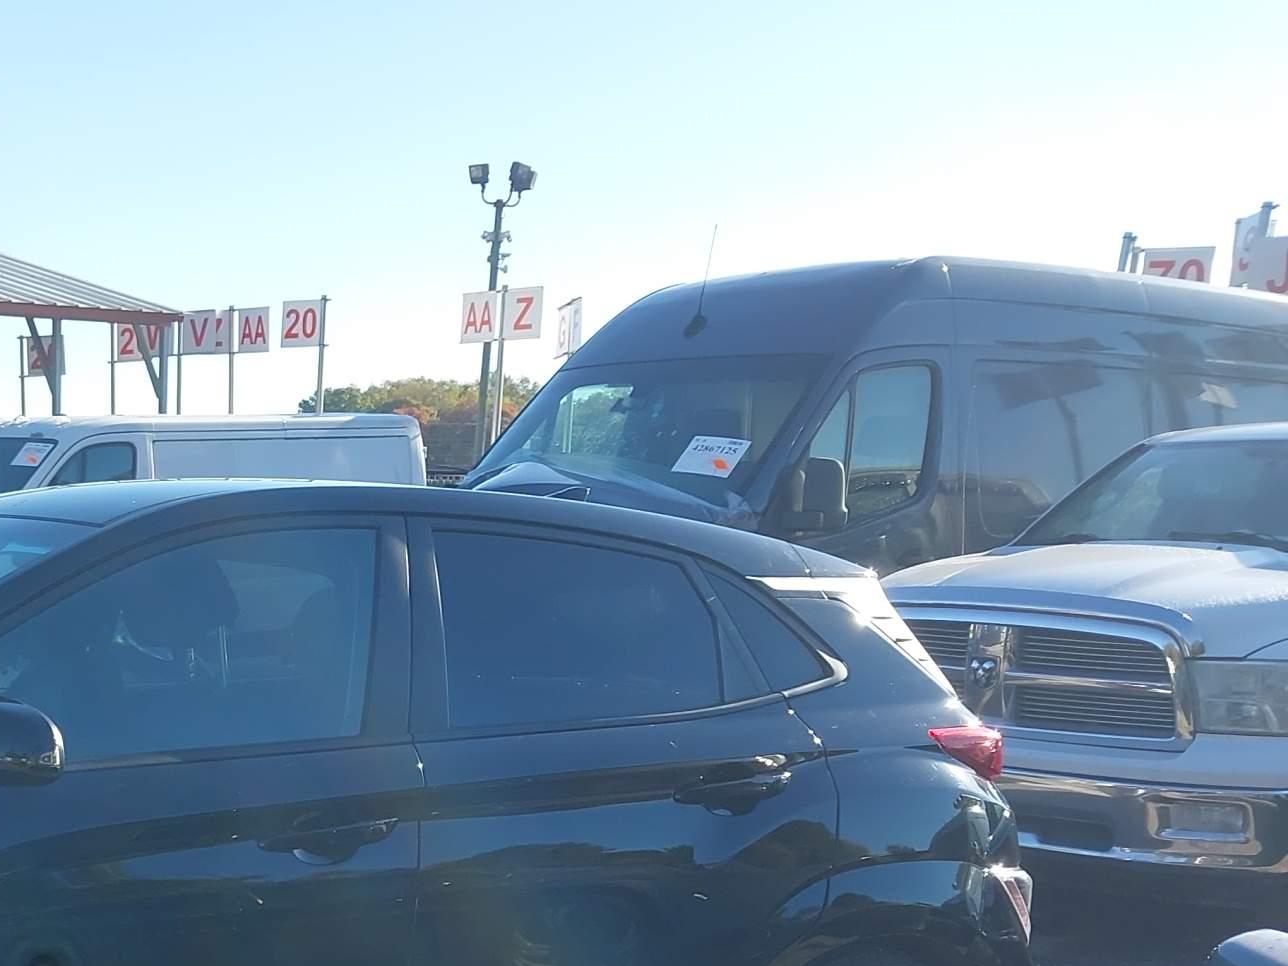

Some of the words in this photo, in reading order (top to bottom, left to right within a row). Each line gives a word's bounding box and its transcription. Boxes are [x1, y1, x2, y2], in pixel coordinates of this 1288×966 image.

[240, 315, 267, 345] AA
[284, 307, 318, 340] 20
[464, 300, 493, 334] AA
[513, 296, 535, 331] Z
[190, 317, 209, 347] V
